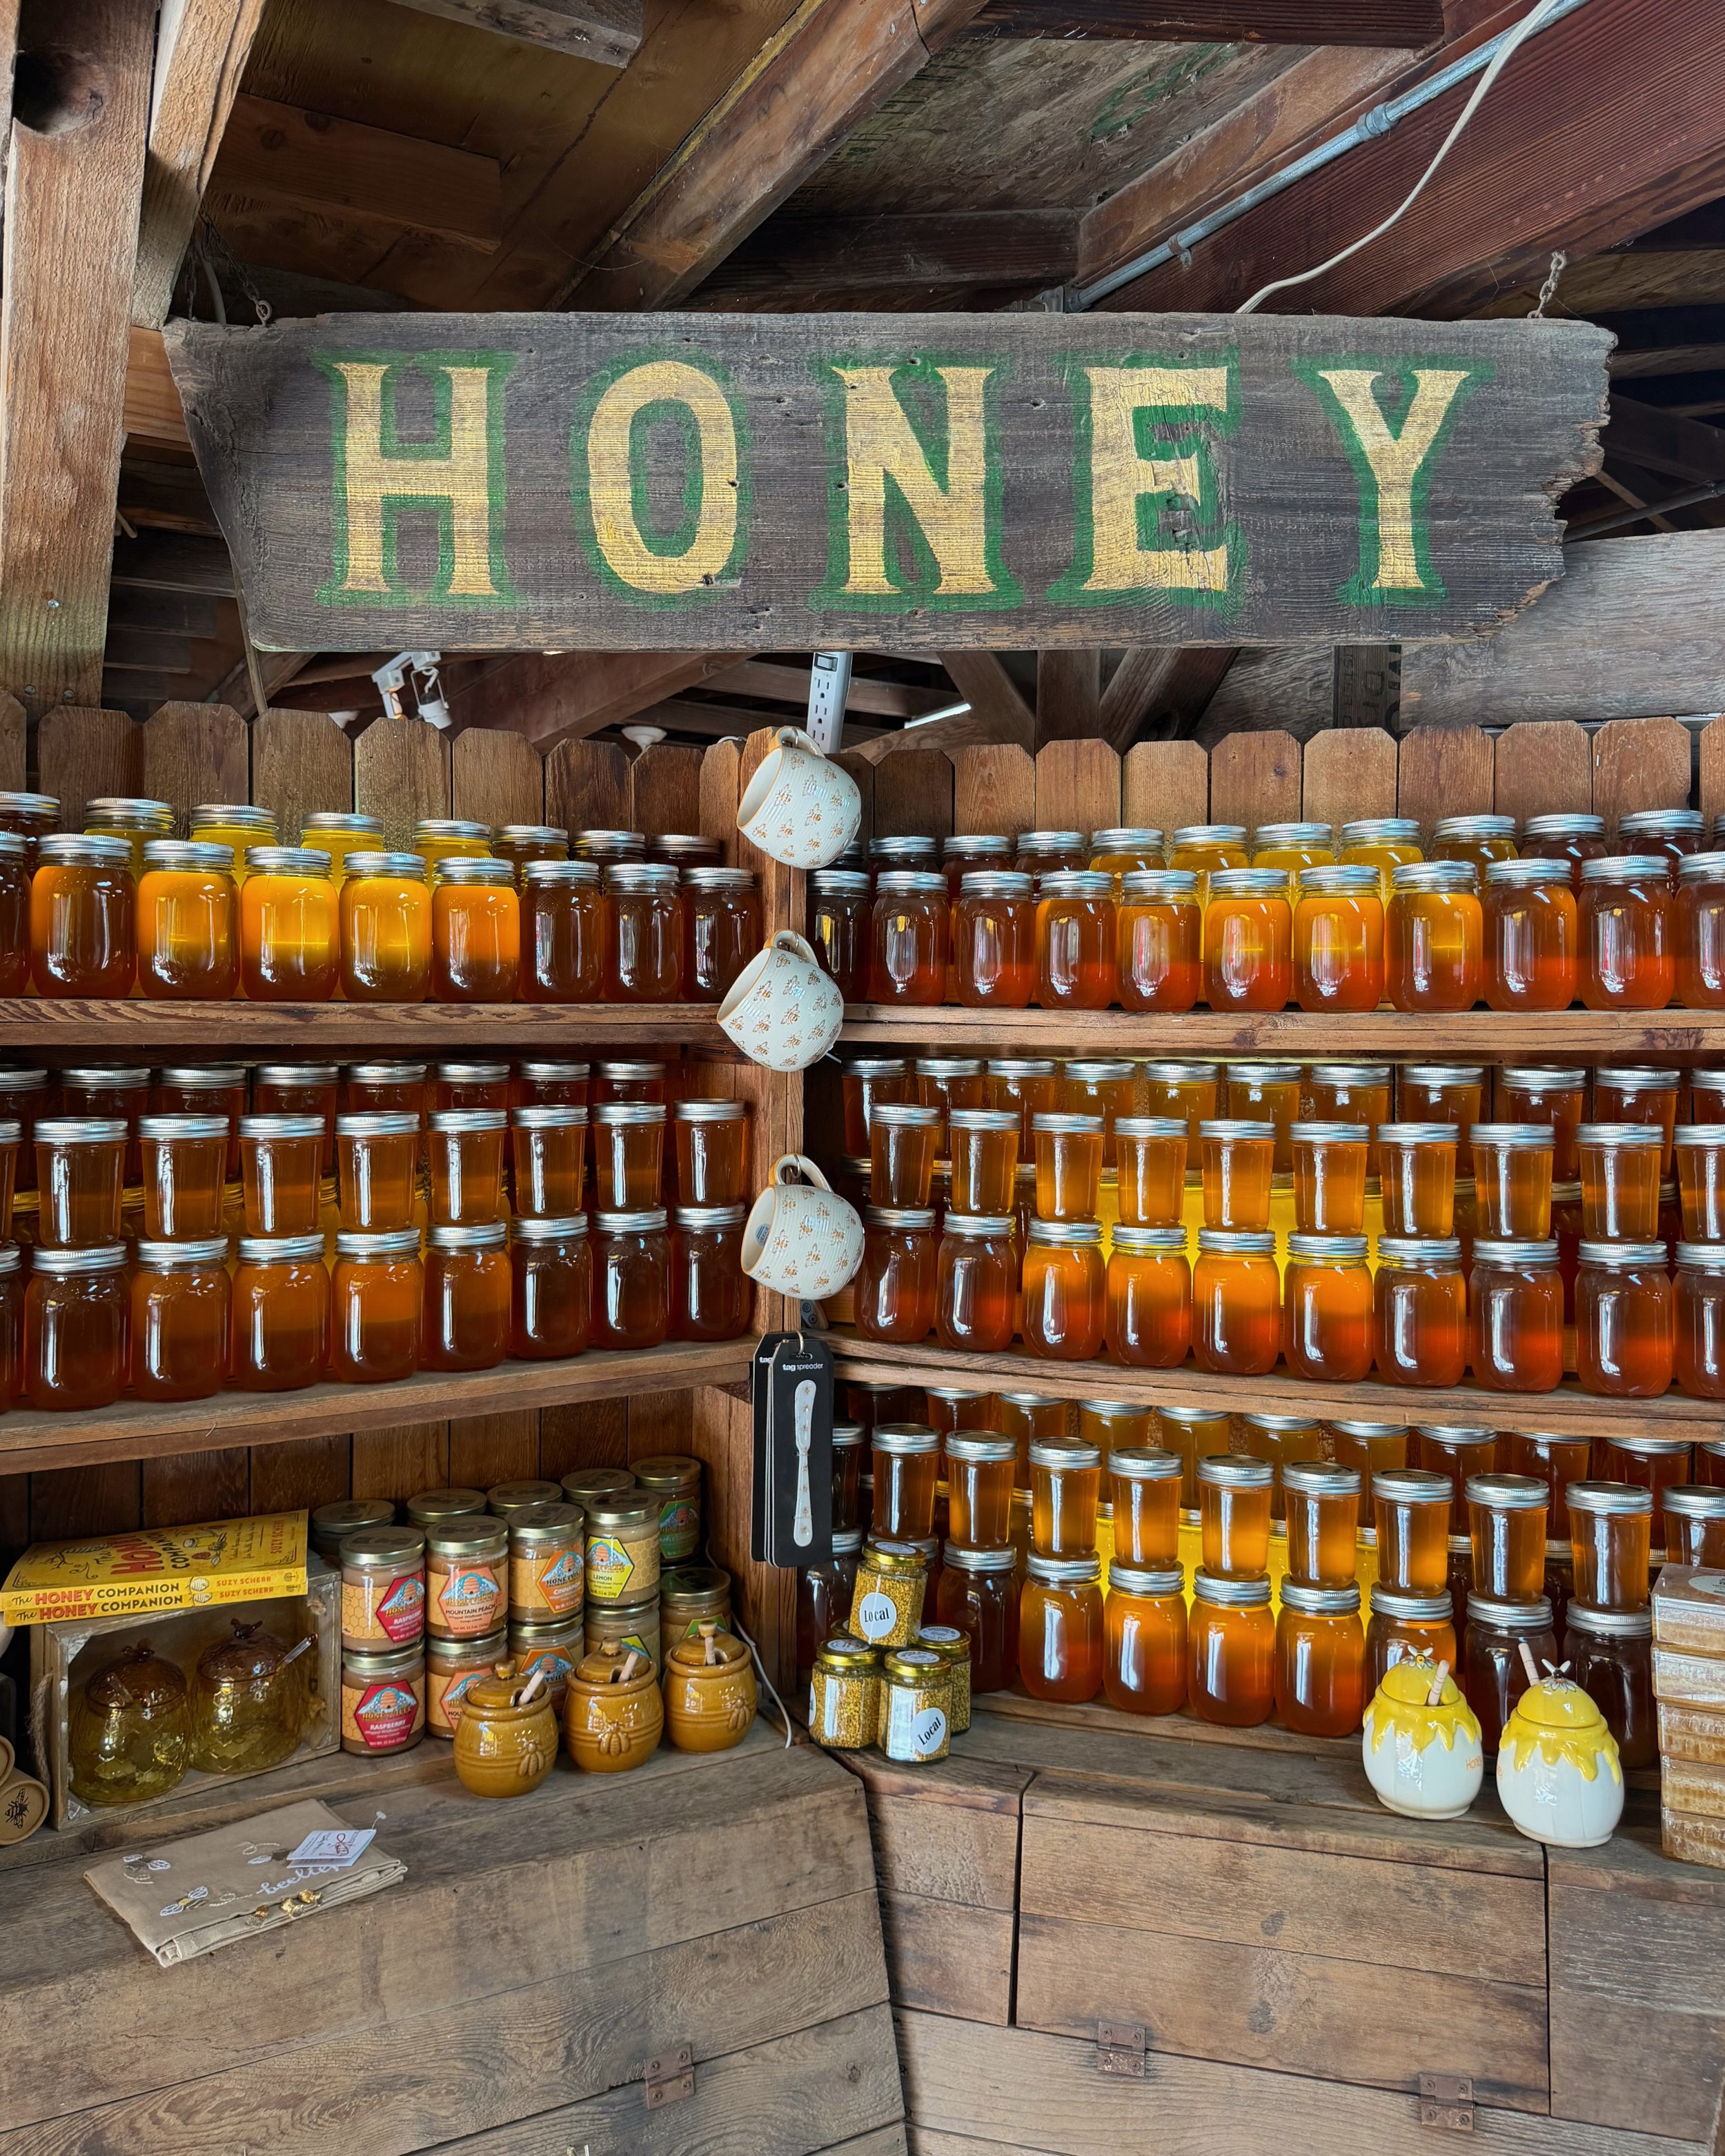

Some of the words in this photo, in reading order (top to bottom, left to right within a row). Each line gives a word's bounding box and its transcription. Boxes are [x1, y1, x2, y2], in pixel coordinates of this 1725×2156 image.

[334, 360, 1470, 595] HONEY
[782, 1363, 796, 1372] tag
[796, 1362, 823, 1371] spreader
[110, 1534, 165, 1574] HONEY
[12, 1596, 32, 1606] The
[35, 1589, 94, 1605] HONEY
[97, 1583, 179, 1599] COMPANION
[217, 1579, 237, 1587] SUZY
[239, 1576, 271, 1585] SCHERR
[17, 1611, 37, 1621] The
[39, 1603, 99, 1619] HONEY
[101, 1595, 183, 1612] COMPANION
[219, 1590, 241, 1598] SUZY
[243, 1586, 274, 1595] SCHERR
[478, 1603, 495, 1612] PEACH
[864, 1608, 889, 1623] Local
[370, 1719, 406, 1730] RASPBERRY
[917, 1717, 941, 1746] Local
